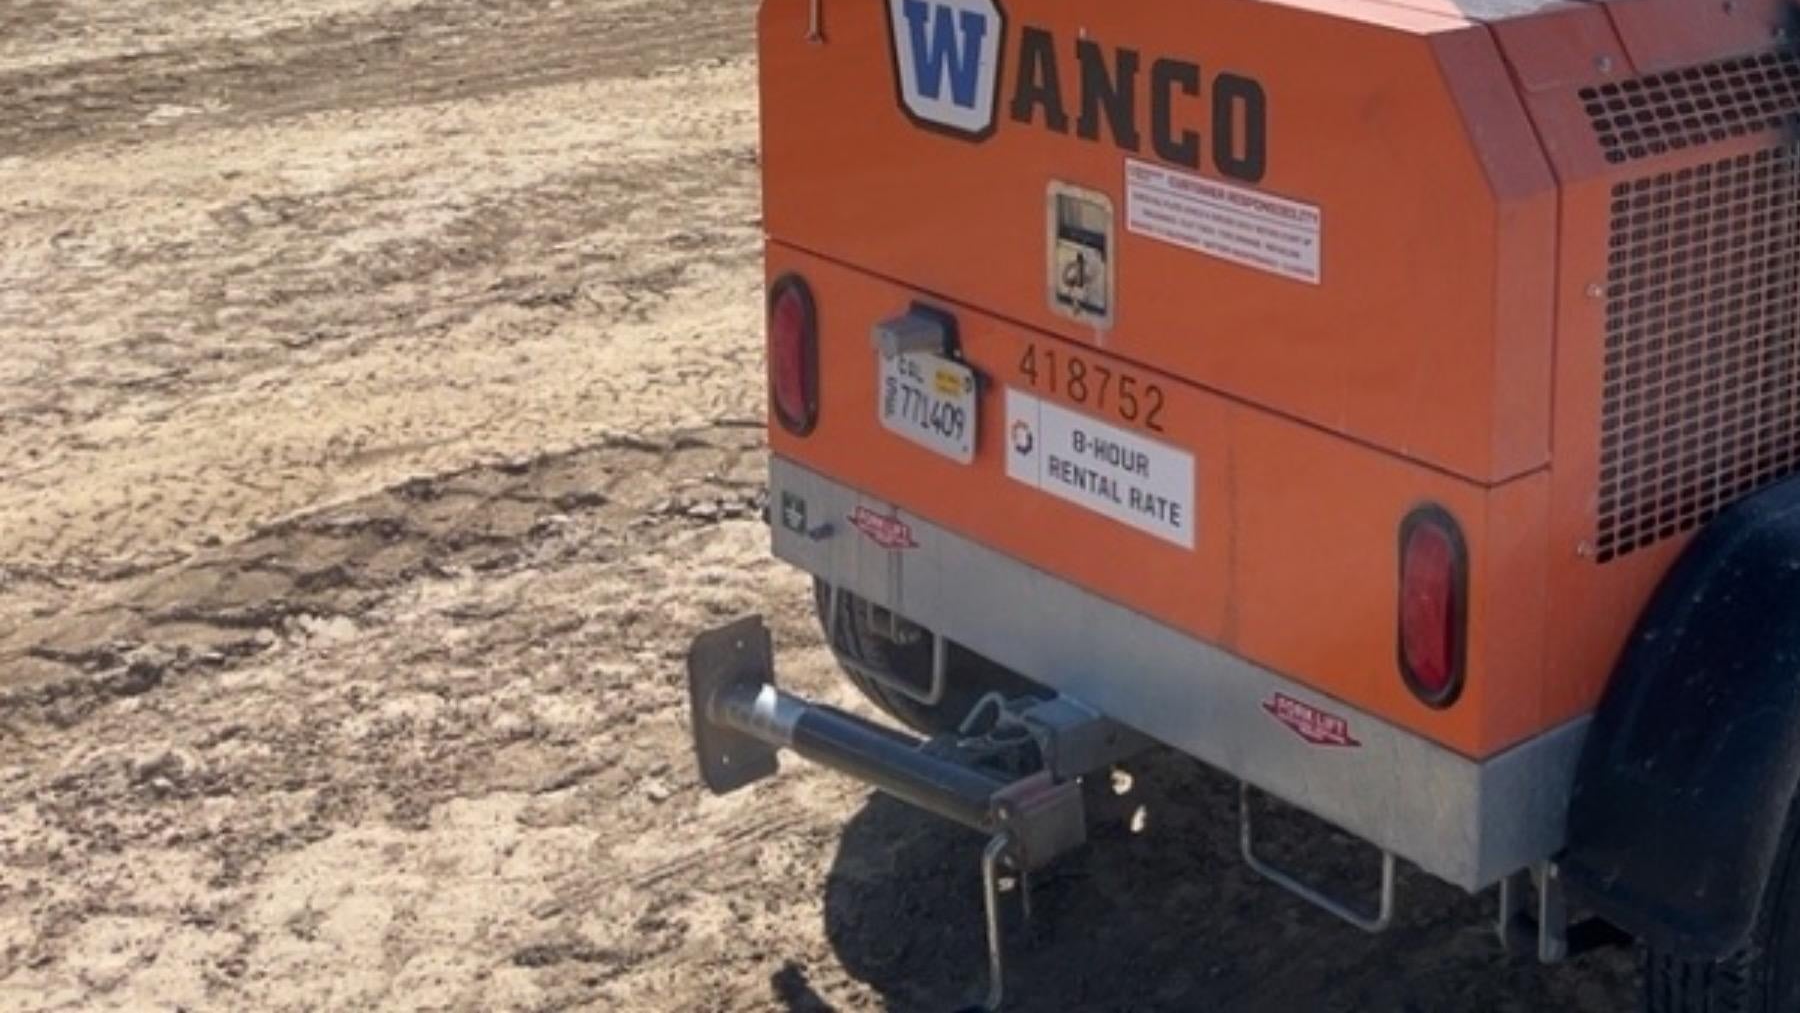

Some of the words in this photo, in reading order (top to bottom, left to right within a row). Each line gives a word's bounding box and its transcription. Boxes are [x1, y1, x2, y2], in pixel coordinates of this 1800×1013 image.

[1019, 342, 1165, 433] 418752
[1048, 453, 1122, 504] RENTAL
[1129, 486, 1182, 529] RATE
[1072, 429, 1150, 478] 8-HOUR
